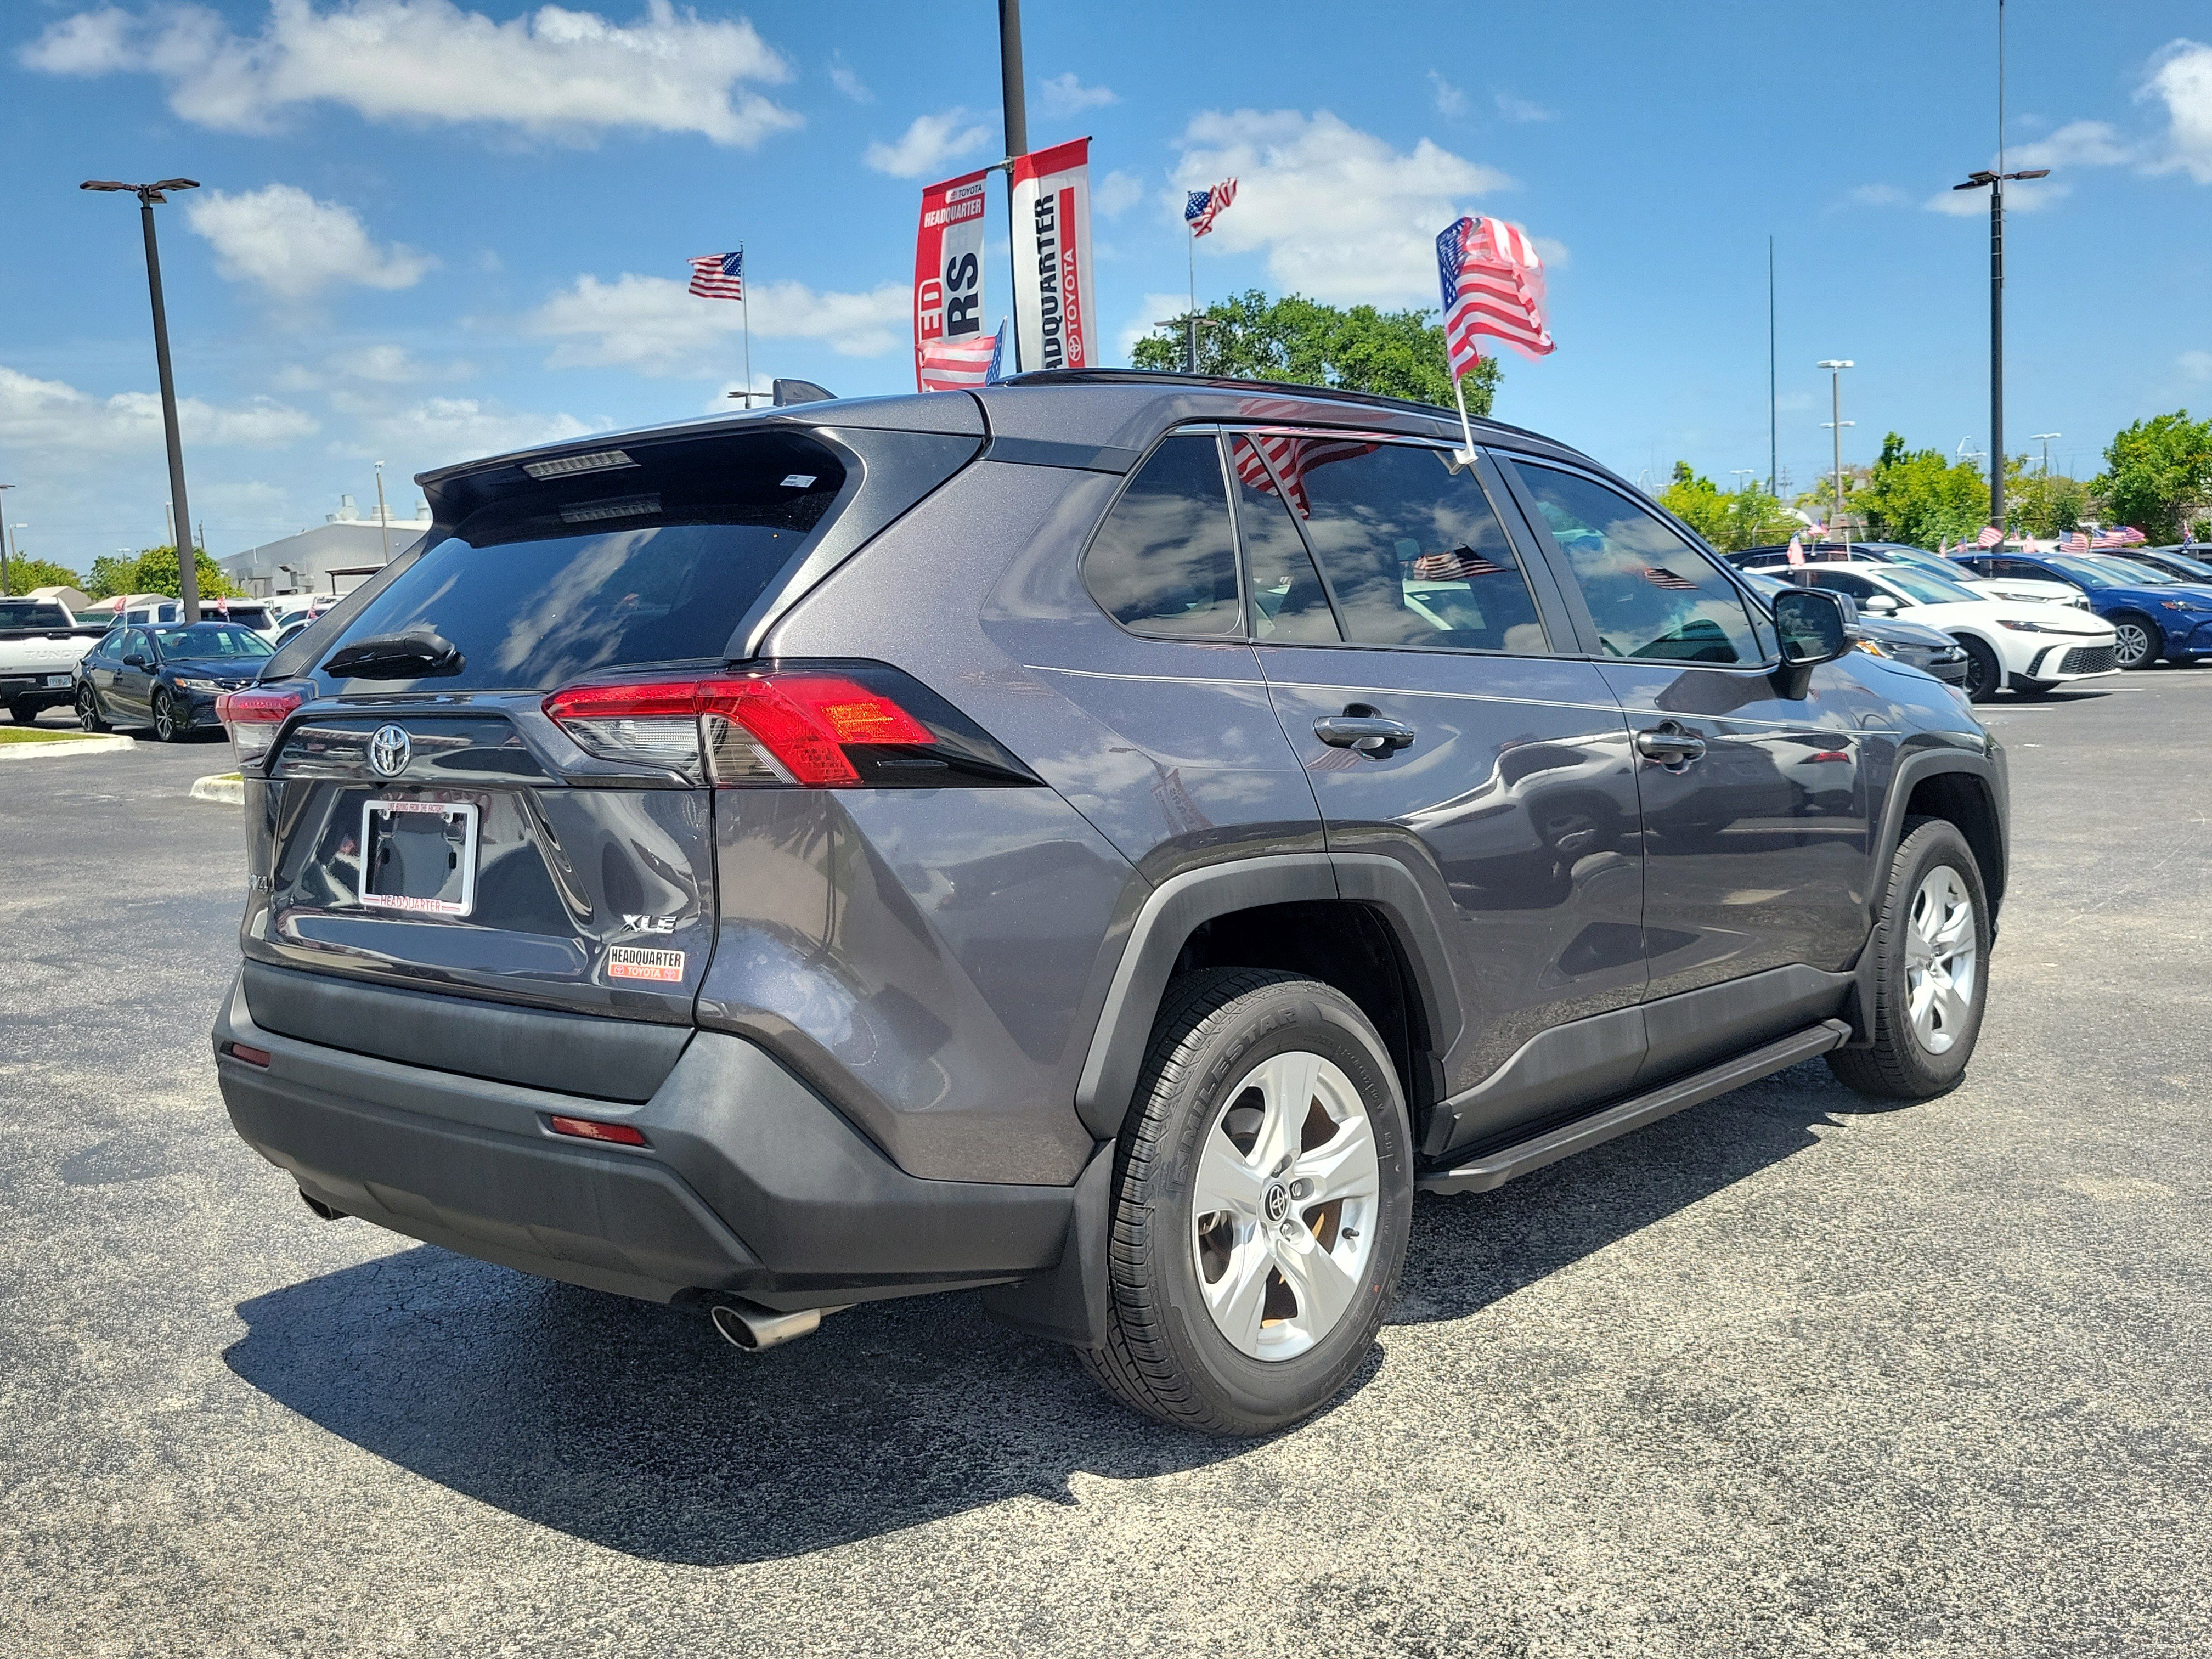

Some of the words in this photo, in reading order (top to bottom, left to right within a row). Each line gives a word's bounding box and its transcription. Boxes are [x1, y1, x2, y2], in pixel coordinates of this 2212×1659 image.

[958, 184, 982, 198] TOYOTA
[923, 198, 982, 228] HEADQUARTER
[946, 252, 980, 339] RS
[1063, 247, 1078, 334] TOYOTA
[381, 894, 441, 912] HEADQUARTER
[619, 913, 678, 934] XLE
[611, 948, 681, 967] HEADQUARTER
[627, 966, 661, 978] TOYOTA
[1180, 1006, 1297, 1153] MILESTAR
